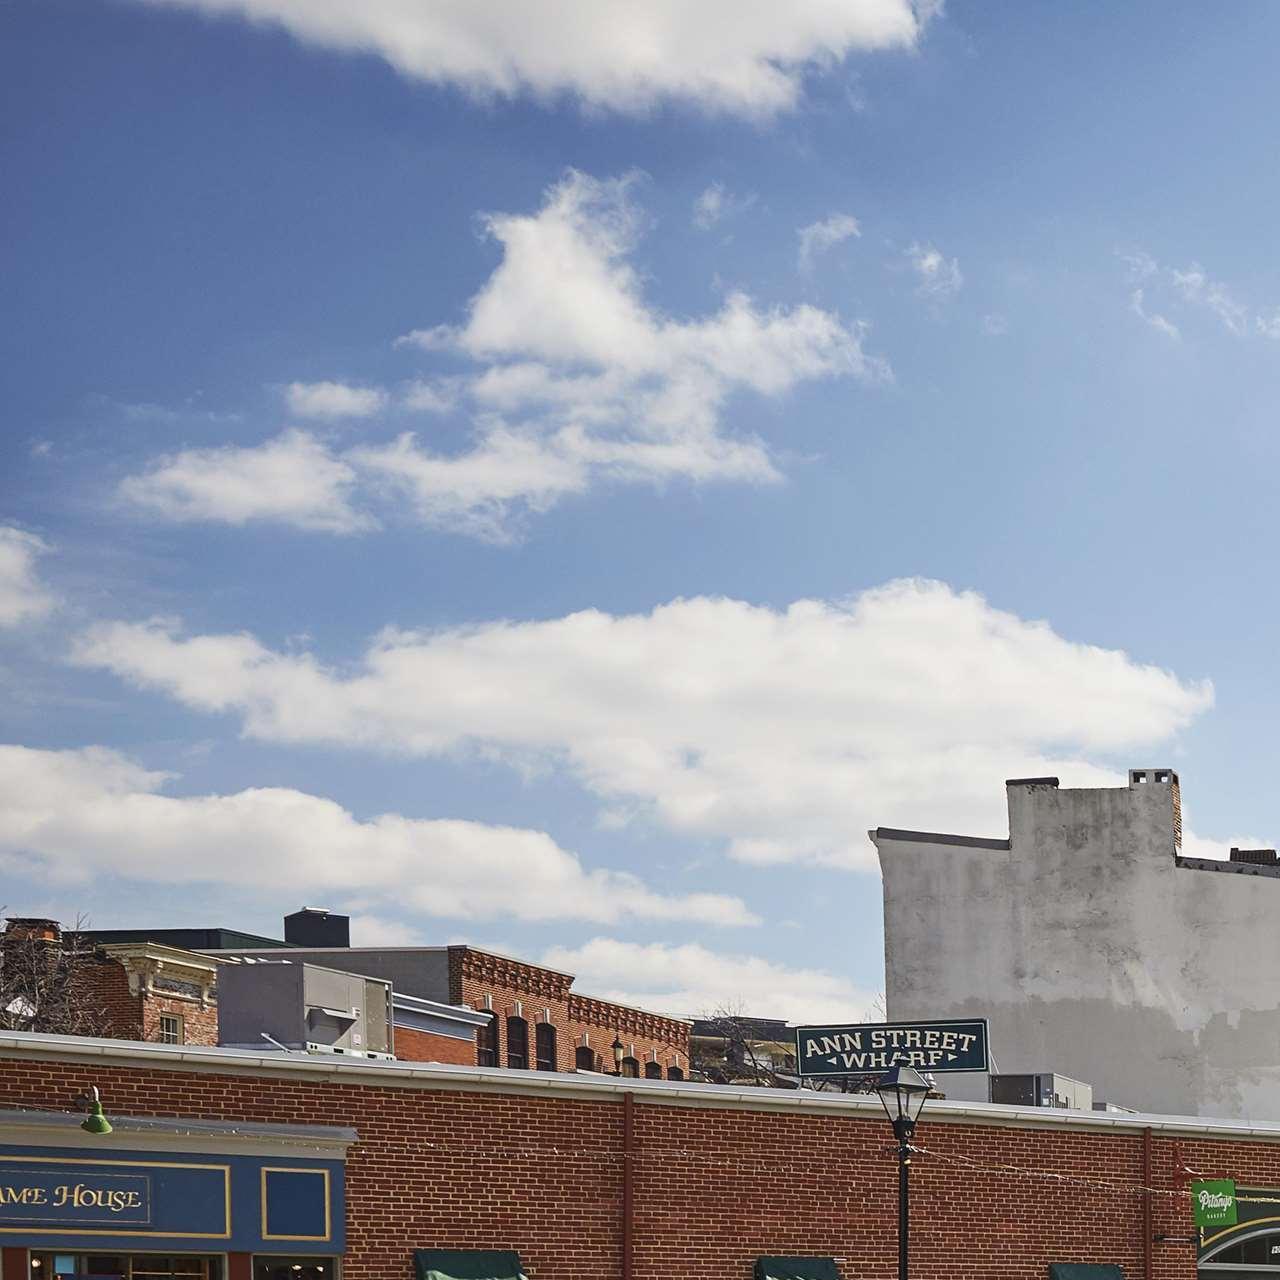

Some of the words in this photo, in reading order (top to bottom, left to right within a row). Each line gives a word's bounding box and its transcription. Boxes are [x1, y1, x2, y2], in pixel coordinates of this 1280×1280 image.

[806, 1032, 862, 1057] ANN
[871, 1030, 977, 1052] STREET
[841, 1050, 944, 1069] WHARF
